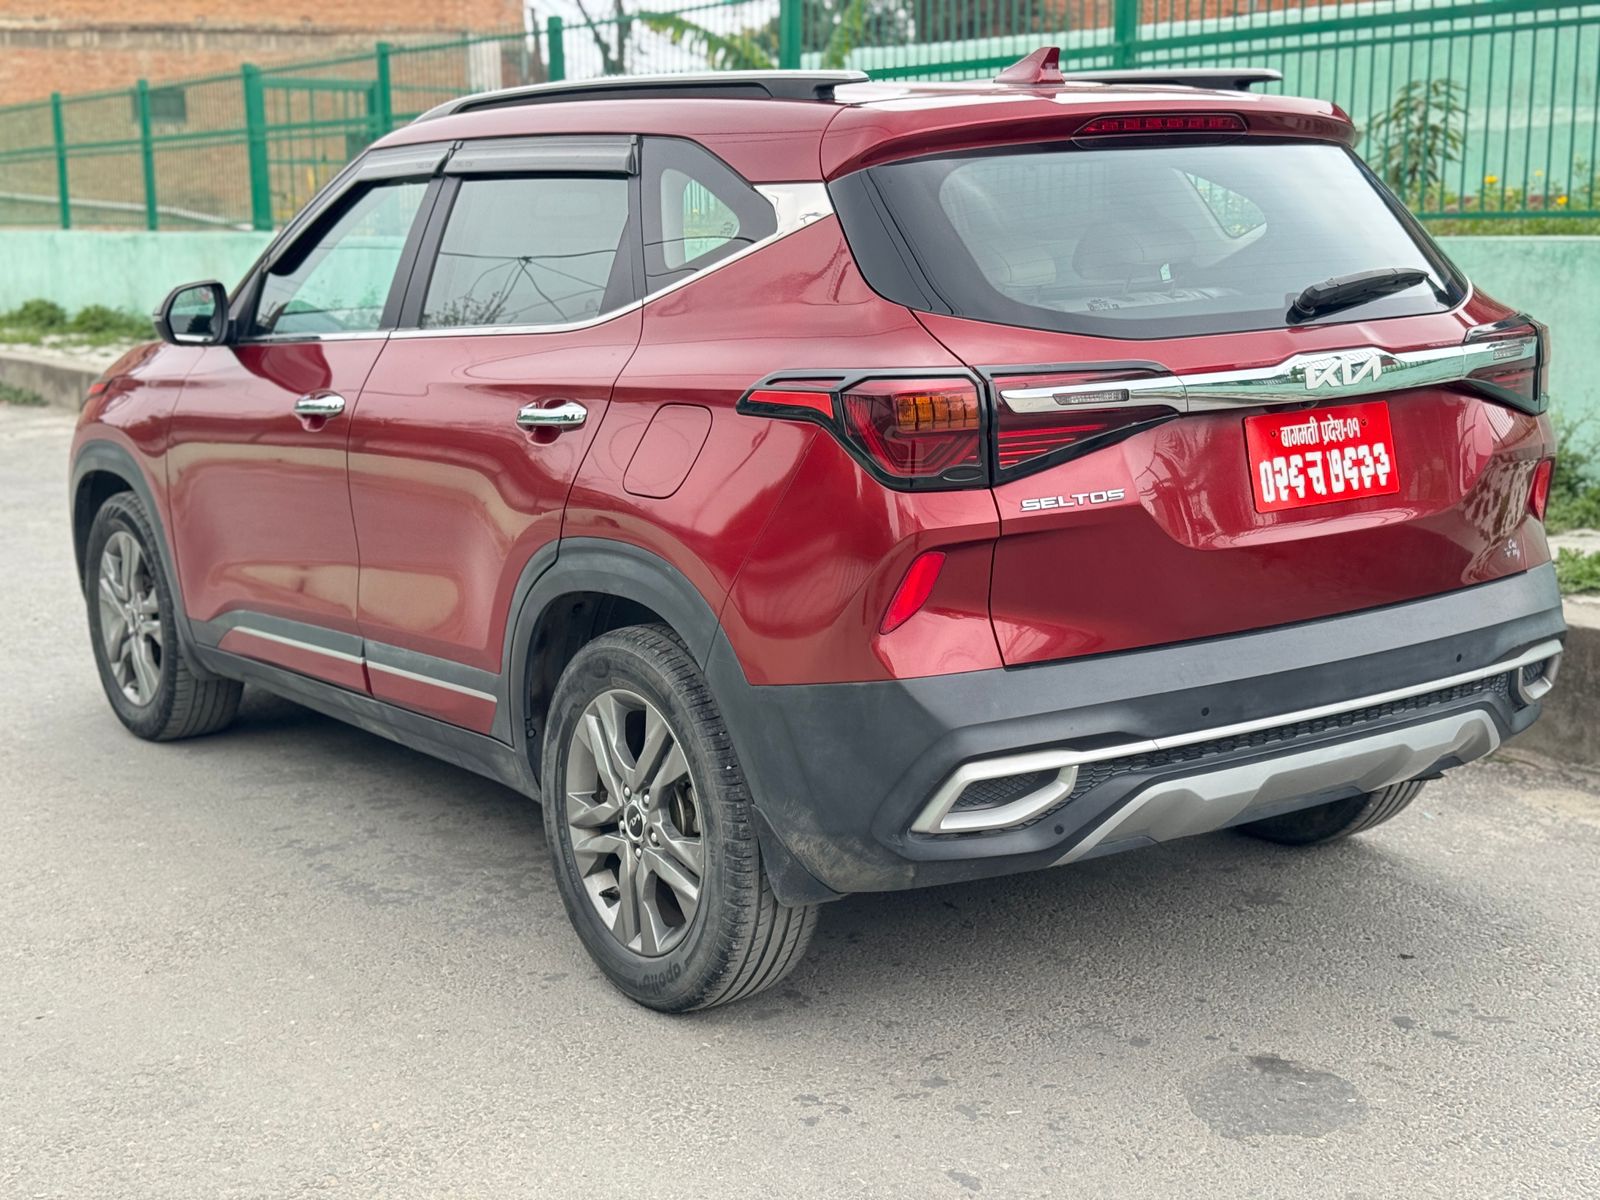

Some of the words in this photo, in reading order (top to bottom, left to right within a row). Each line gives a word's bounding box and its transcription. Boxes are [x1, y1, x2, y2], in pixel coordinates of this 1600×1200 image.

[1305, 355, 1382, 390] KIA
[1281, 416, 1319, 447] बागमती
[1021, 488, 1125, 511] SELTOS
